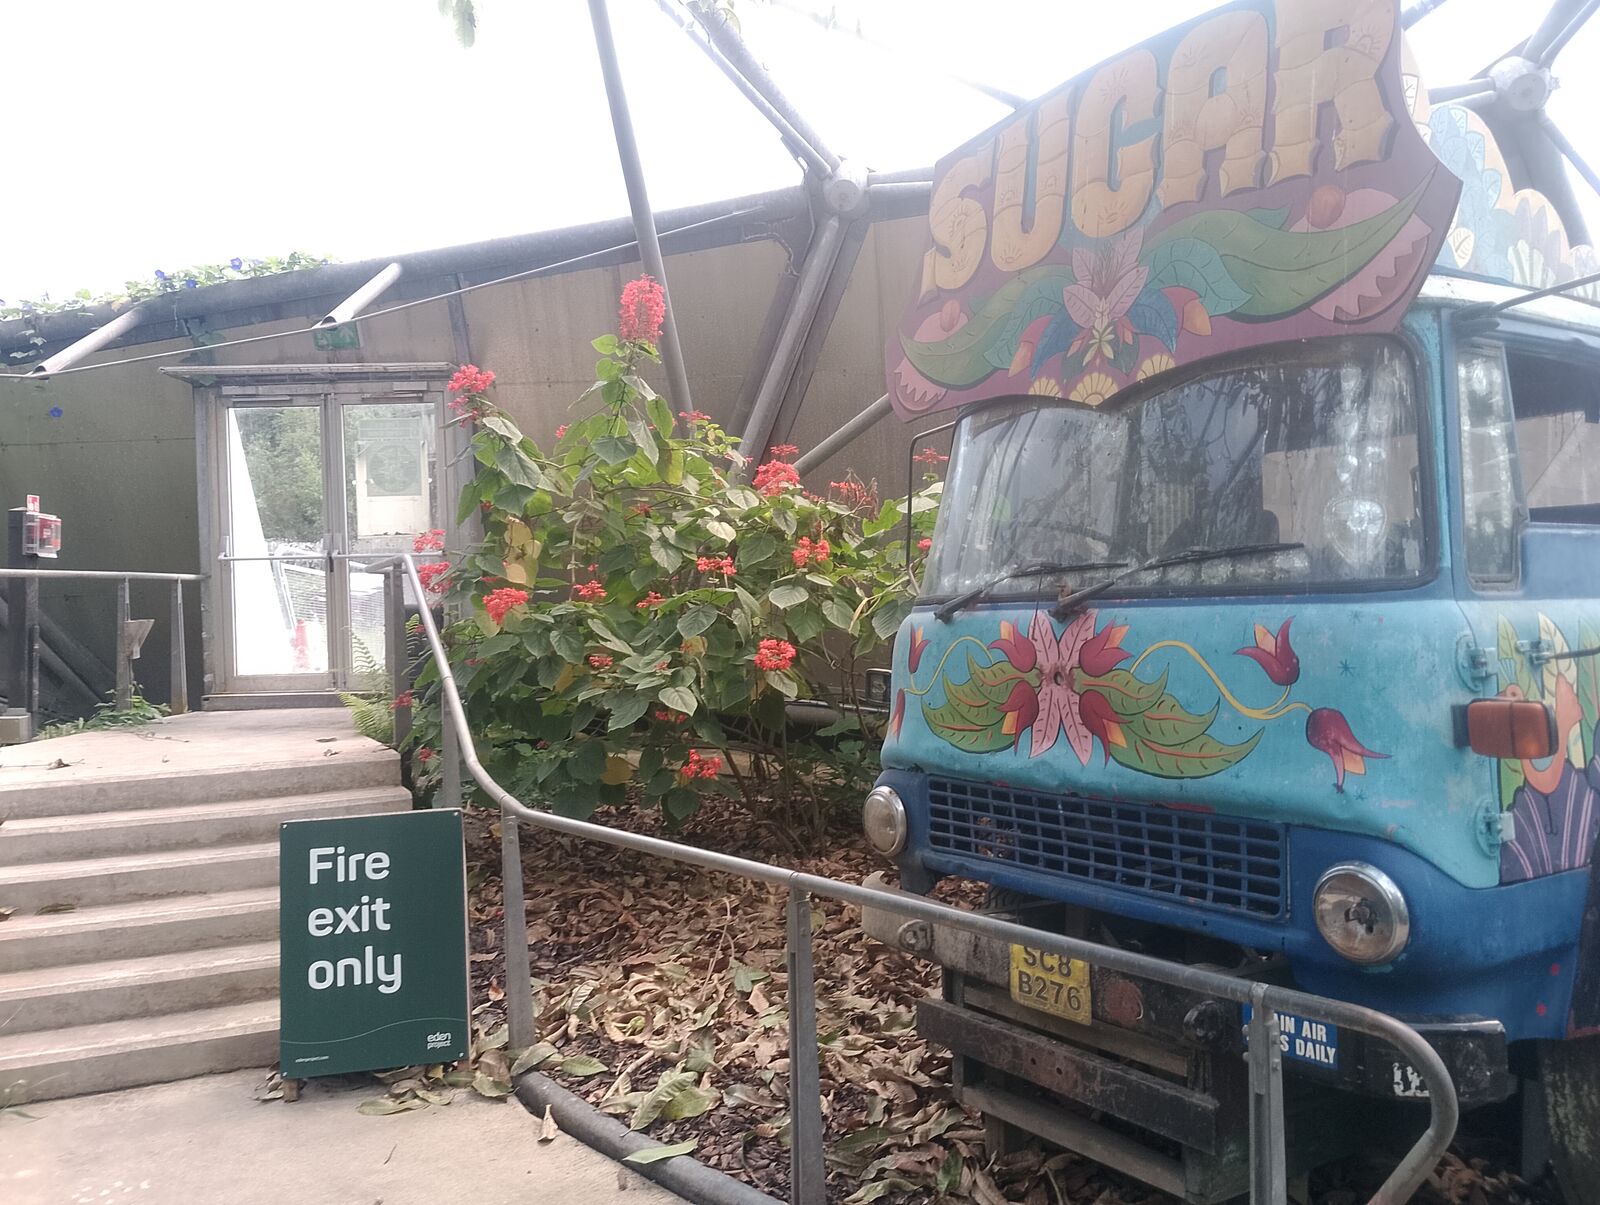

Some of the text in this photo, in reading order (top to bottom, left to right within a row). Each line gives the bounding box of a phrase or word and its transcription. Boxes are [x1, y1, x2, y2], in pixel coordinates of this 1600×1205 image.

[309, 846, 391, 884] Fire
[307, 895, 391, 937] exit
[307, 946, 402, 994] only
[1019, 969, 1081, 1011] B276
[1295, 1038, 1336, 1064] DAILY
[1301, 1020, 1327, 1043] AIR
